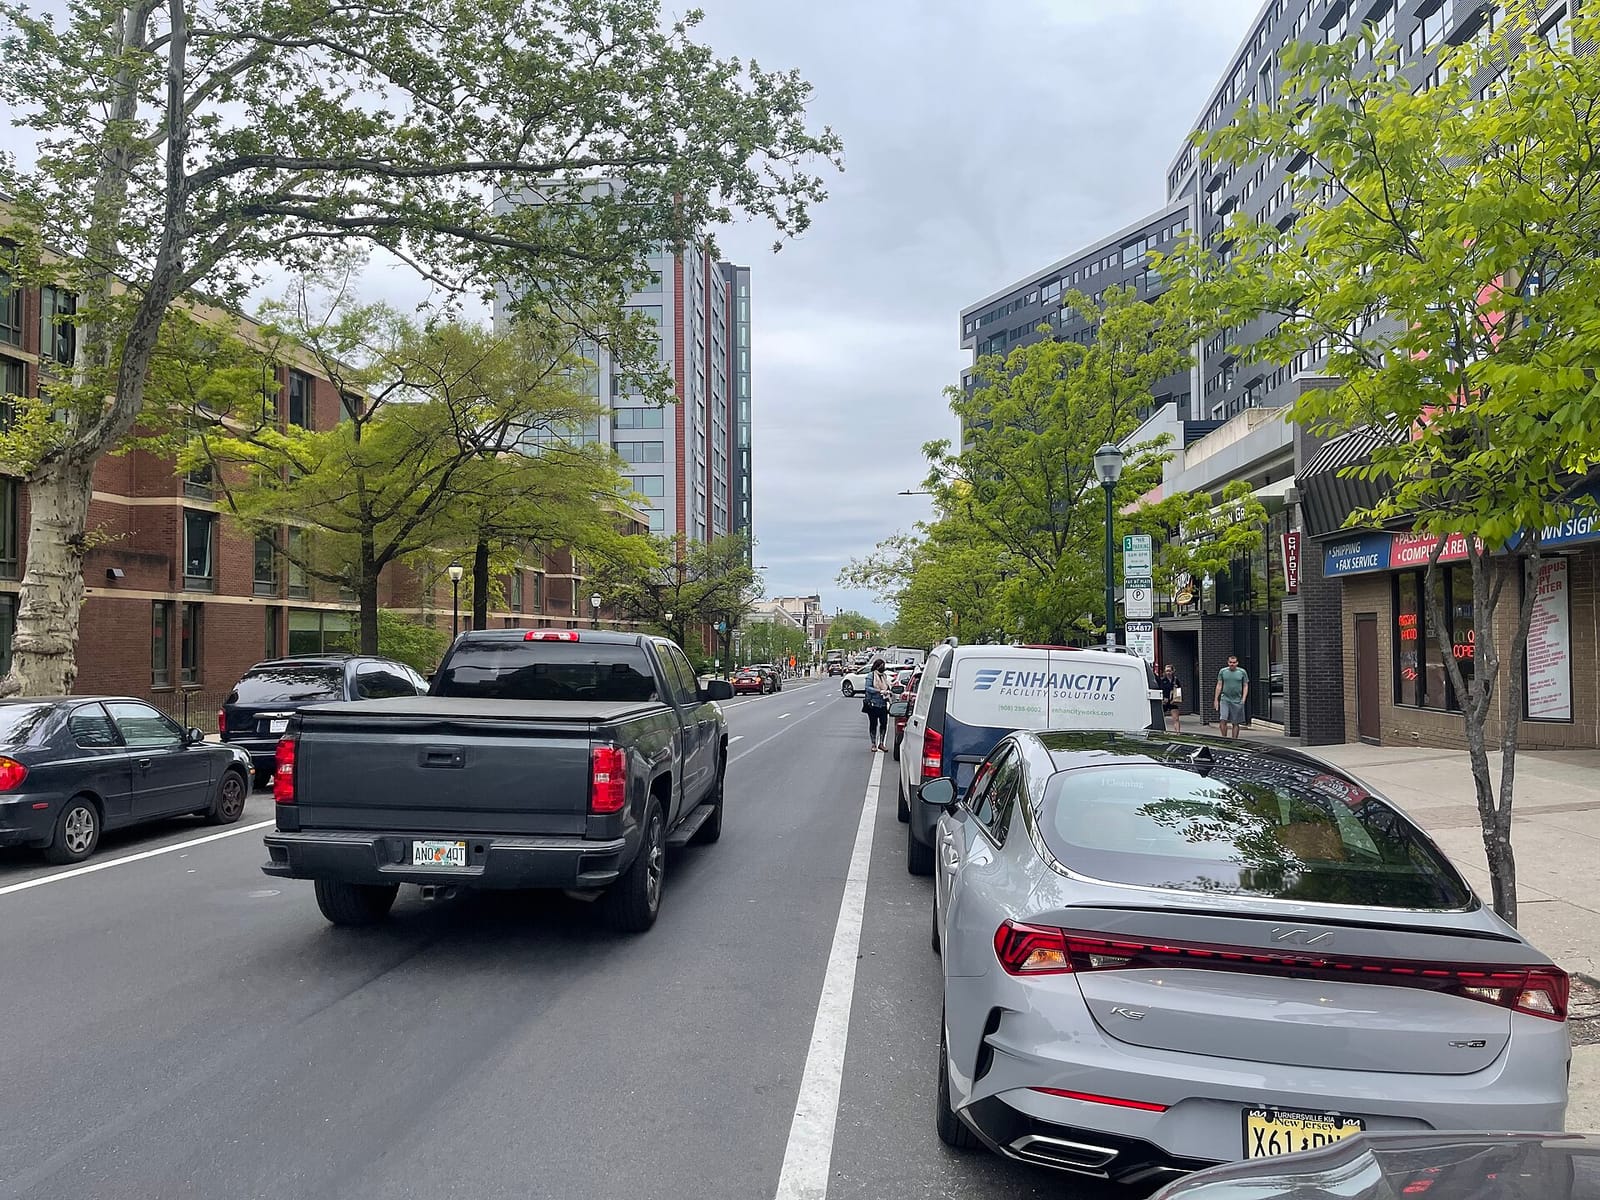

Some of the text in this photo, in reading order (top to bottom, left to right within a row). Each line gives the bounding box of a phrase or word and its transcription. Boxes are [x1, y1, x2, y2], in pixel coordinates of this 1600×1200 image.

[1565, 515, 1600, 537] SIGN
[1126, 538, 1132, 549] 3
[1331, 541, 1361, 558] SHIPPING
[1288, 537, 1297, 587] CHIPOTLE
[1339, 555, 1378, 571] FAX SERVICE
[1537, 581, 1562, 595] NTER
[1002, 670, 1121, 692] ENHANCITY
[1000, 687, 1116, 702] FACILITY SOLUTIONS
[1273, 1111, 1323, 1122] TURNERSVILLE
[1274, 1118, 1334, 1133] New Jersey
[1253, 1127, 1291, 1157] X61
